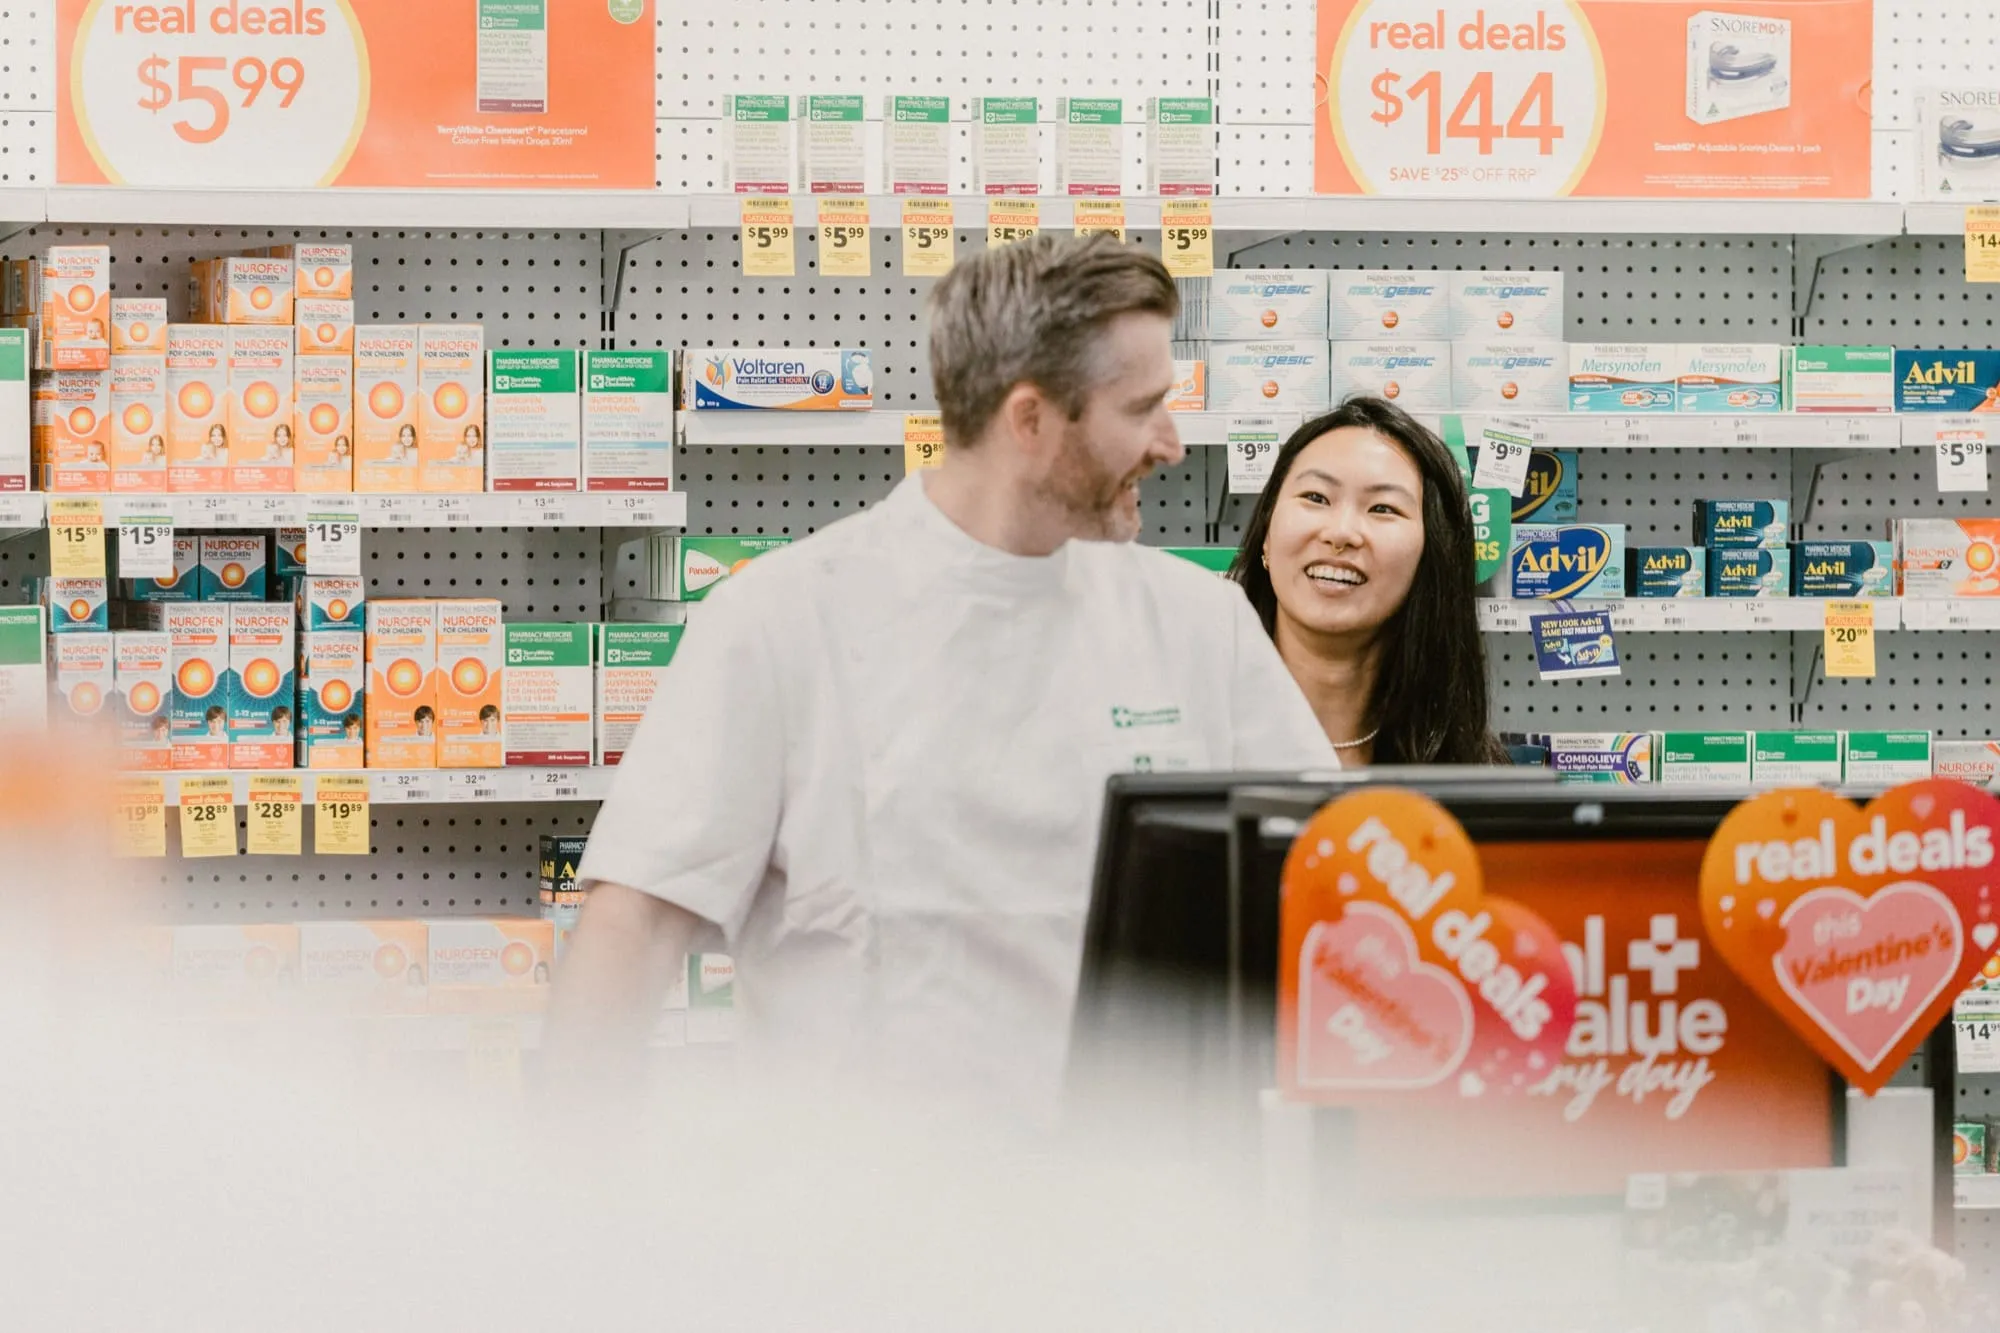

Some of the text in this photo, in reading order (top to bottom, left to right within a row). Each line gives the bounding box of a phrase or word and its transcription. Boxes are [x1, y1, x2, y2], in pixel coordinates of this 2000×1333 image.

[114, 0, 326, 35] real deals
[1369, 10, 1566, 51] real deals
[1940, 91, 2000, 106] SNORE
[1370, 68, 1564, 155] $144
[1389, 167, 1433, 181] SAVE
[1472, 168, 1507, 181] OFF
[1971, 233, 2000, 248] $14
[301, 248, 347, 256] NUROFEN
[234, 263, 288, 274] NUROFEN
[116, 303, 161, 312] NUROFEN
[169, 340, 223, 349] NUROFEN
[235, 340, 288, 349] NUROFEN
[360, 340, 413, 350] NUROFEN
[424, 340, 478, 351] NUROFEN
[376, 350, 404, 358] CHILDREN
[732, 358, 804, 374] Voltaren
[1581, 358, 1661, 373] Mersynofen
[1689, 359, 1766, 373] Mersynofen
[302, 368, 346, 377] NUROFEN
[1903, 361, 1975, 384] Advil
[58, 379, 101, 388] NUROFEN
[1715, 514, 1753, 529] Advil
[204, 540, 259, 550] NUROFEN
[1517, 546, 1597, 572] Advil
[1907, 548, 1962, 559] NUROMOL
[1644, 555, 1685, 570] Advil
[688, 565, 720, 576] Panadol
[1721, 563, 1757, 577] Advil
[1806, 561, 1845, 576] Advil
[56, 580, 101, 589] NUROFEN
[313, 580, 360, 588] NUROFEN
[169, 616, 223, 626] NUROFEN
[235, 616, 288, 626] NUROFEN
[378, 616, 431, 627] NUROFEN
[443, 616, 496, 626] NUROFEN
[1541, 617, 1602, 629] NEW LOOK Advil
[508, 631, 573, 639] PHARMACY MEDICINE
[608, 631, 670, 639] PHARMACY MEDICINE
[1541, 625, 1604, 637] SAME FAST PAIN RELIEF
[121, 646, 167, 655] NUROFEN
[313, 644, 359, 653] NUROFEN
[604, 670, 652, 678] IBUPROFEN
[604, 679, 657, 687] SUSPENSION
[1557, 753, 1622, 764] COMBOLIEVE
[1938, 761, 1994, 771] NUROFEN
[1735, 809, 1994, 885] real deals
[1347, 816, 1456, 921] real
[1432, 908, 1553, 1040] deals
[434, 948, 499, 961] NUROFEN
[1792, 921, 1953, 988] Valentine's
[1846, 974, 1910, 1015] Day
[1567, 975, 1727, 1056] alue
[1616, 1048, 1715, 1121] day
